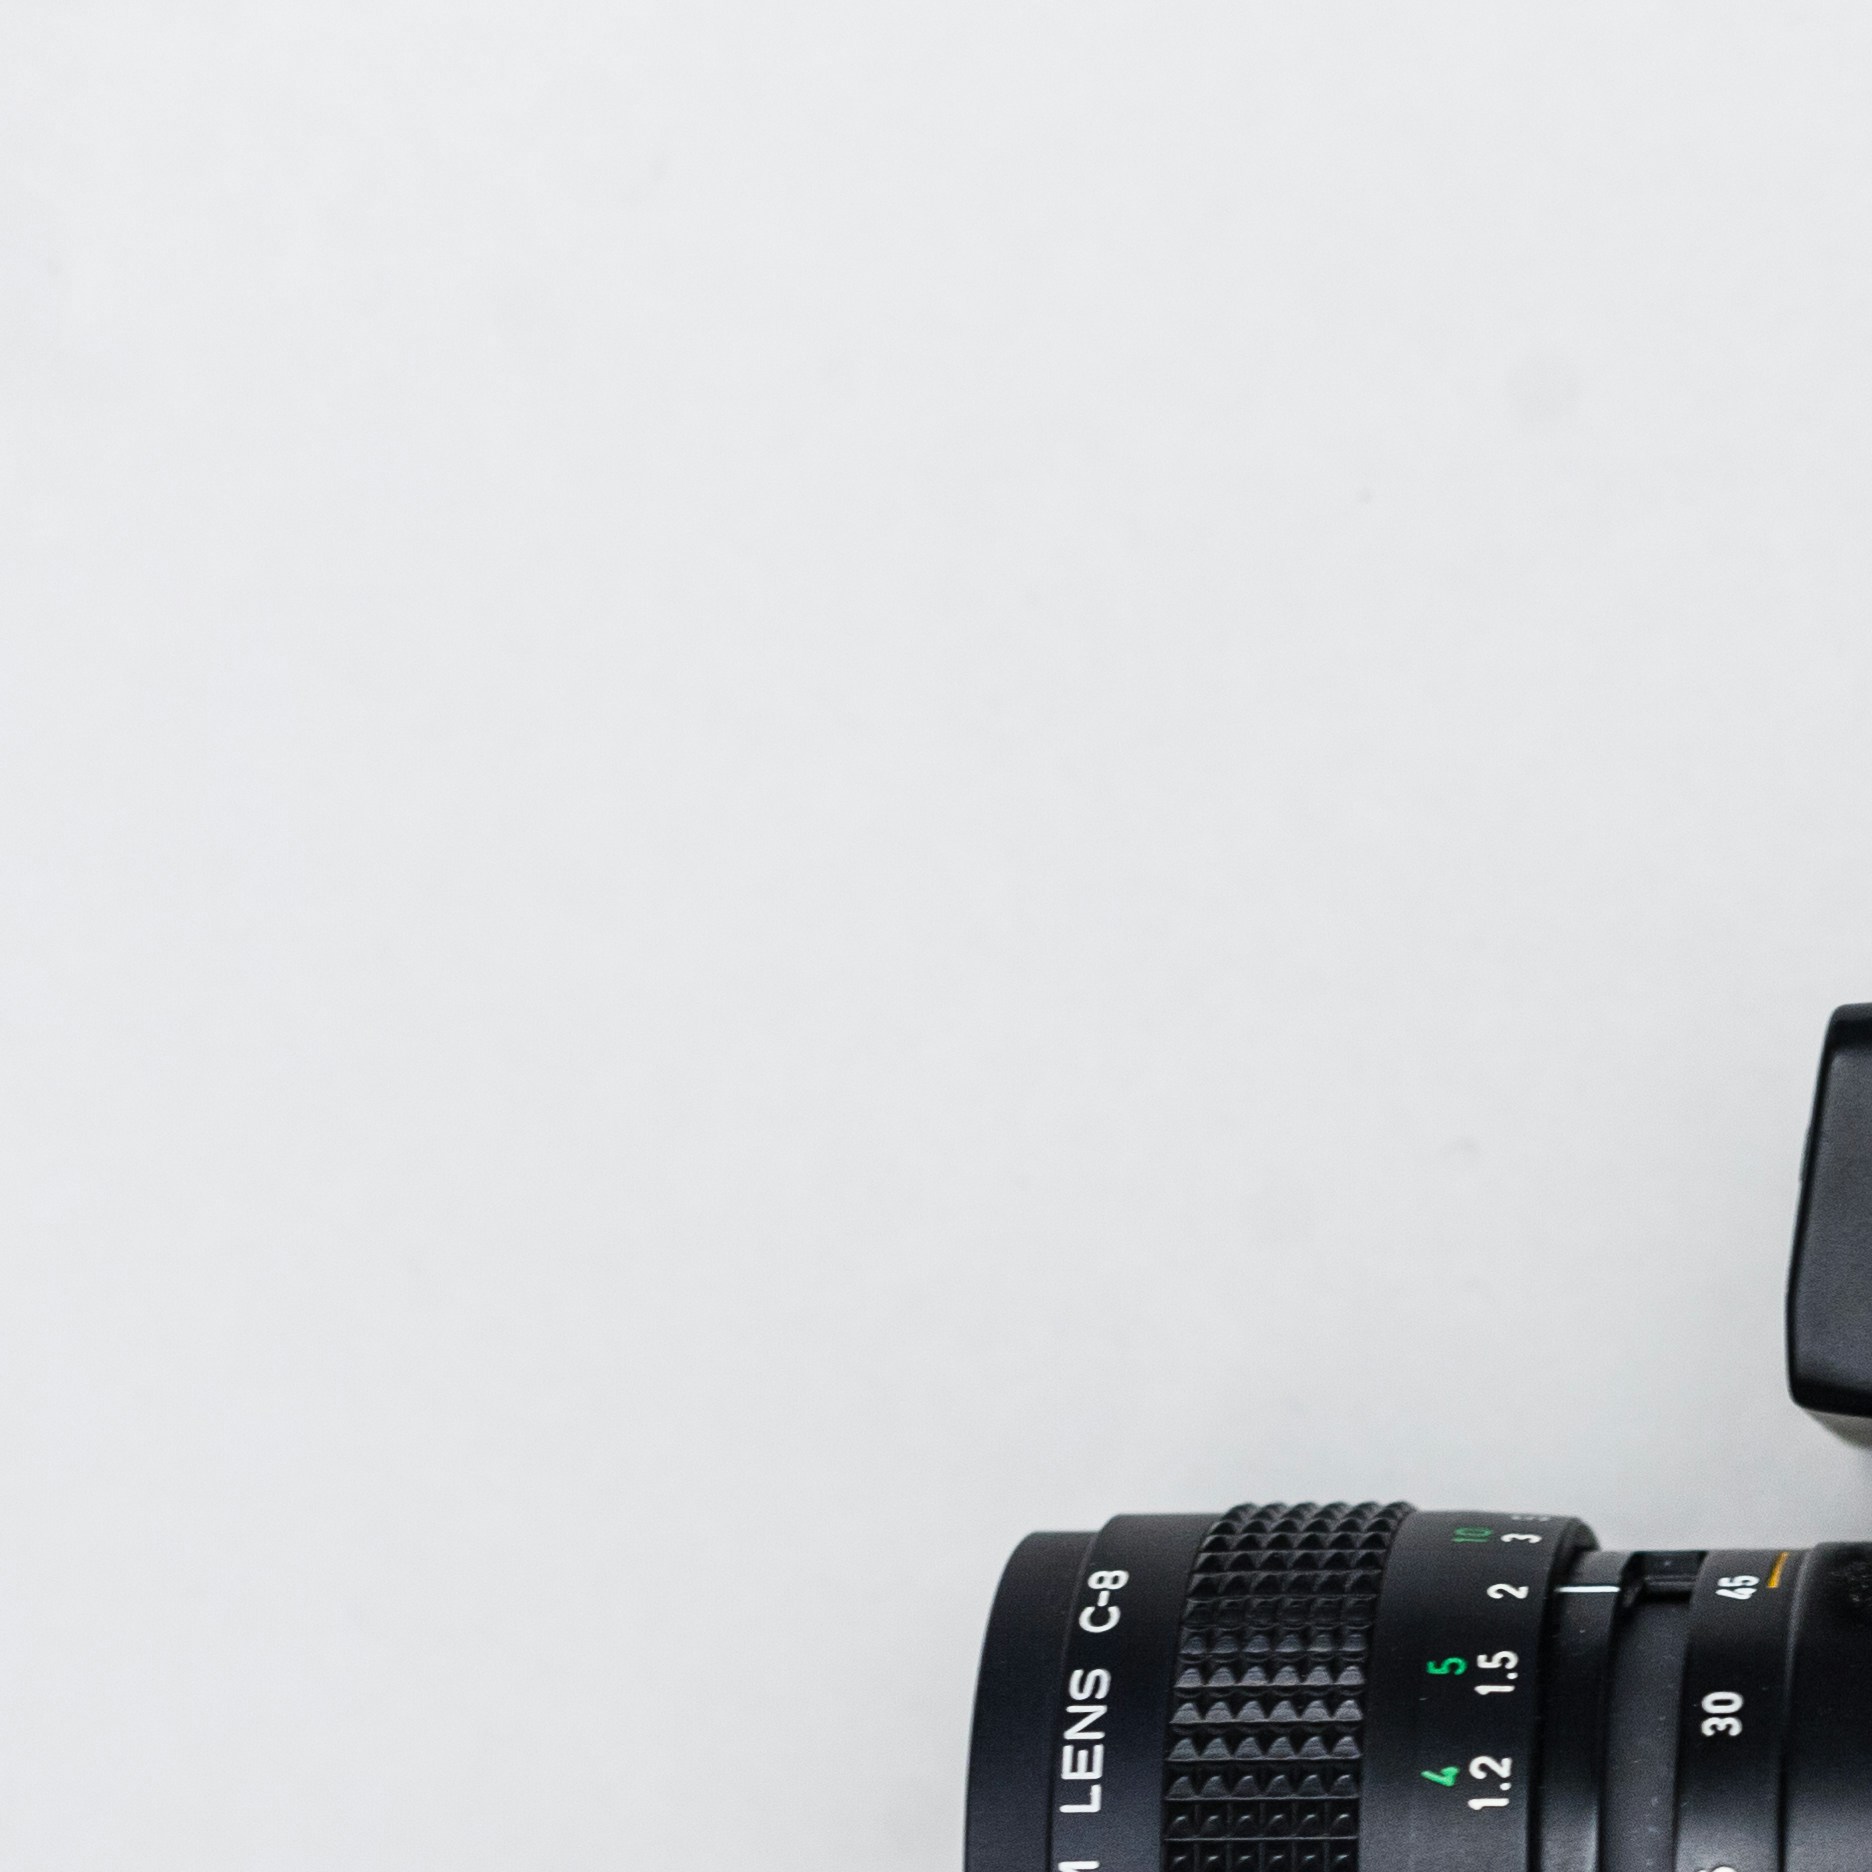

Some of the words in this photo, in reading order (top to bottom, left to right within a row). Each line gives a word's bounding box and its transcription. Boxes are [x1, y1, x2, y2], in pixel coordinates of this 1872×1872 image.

[1451, 1526, 1494, 1543] 10
[1499, 1532, 1543, 1545] 3
[1078, 1568, 1130, 1634] C-8
[1485, 1582, 1530, 1600] 2
[1714, 1574, 1761, 1601] 45
[1425, 1656, 1468, 1676] 5
[1473, 1650, 1519, 1696] 1.5
[1700, 1690, 1744, 1738] 30
[1058, 1667, 1112, 1815] LENS
[1420, 1765, 1461, 1787] 4
[1467, 1755, 1513, 1811] 1.2
